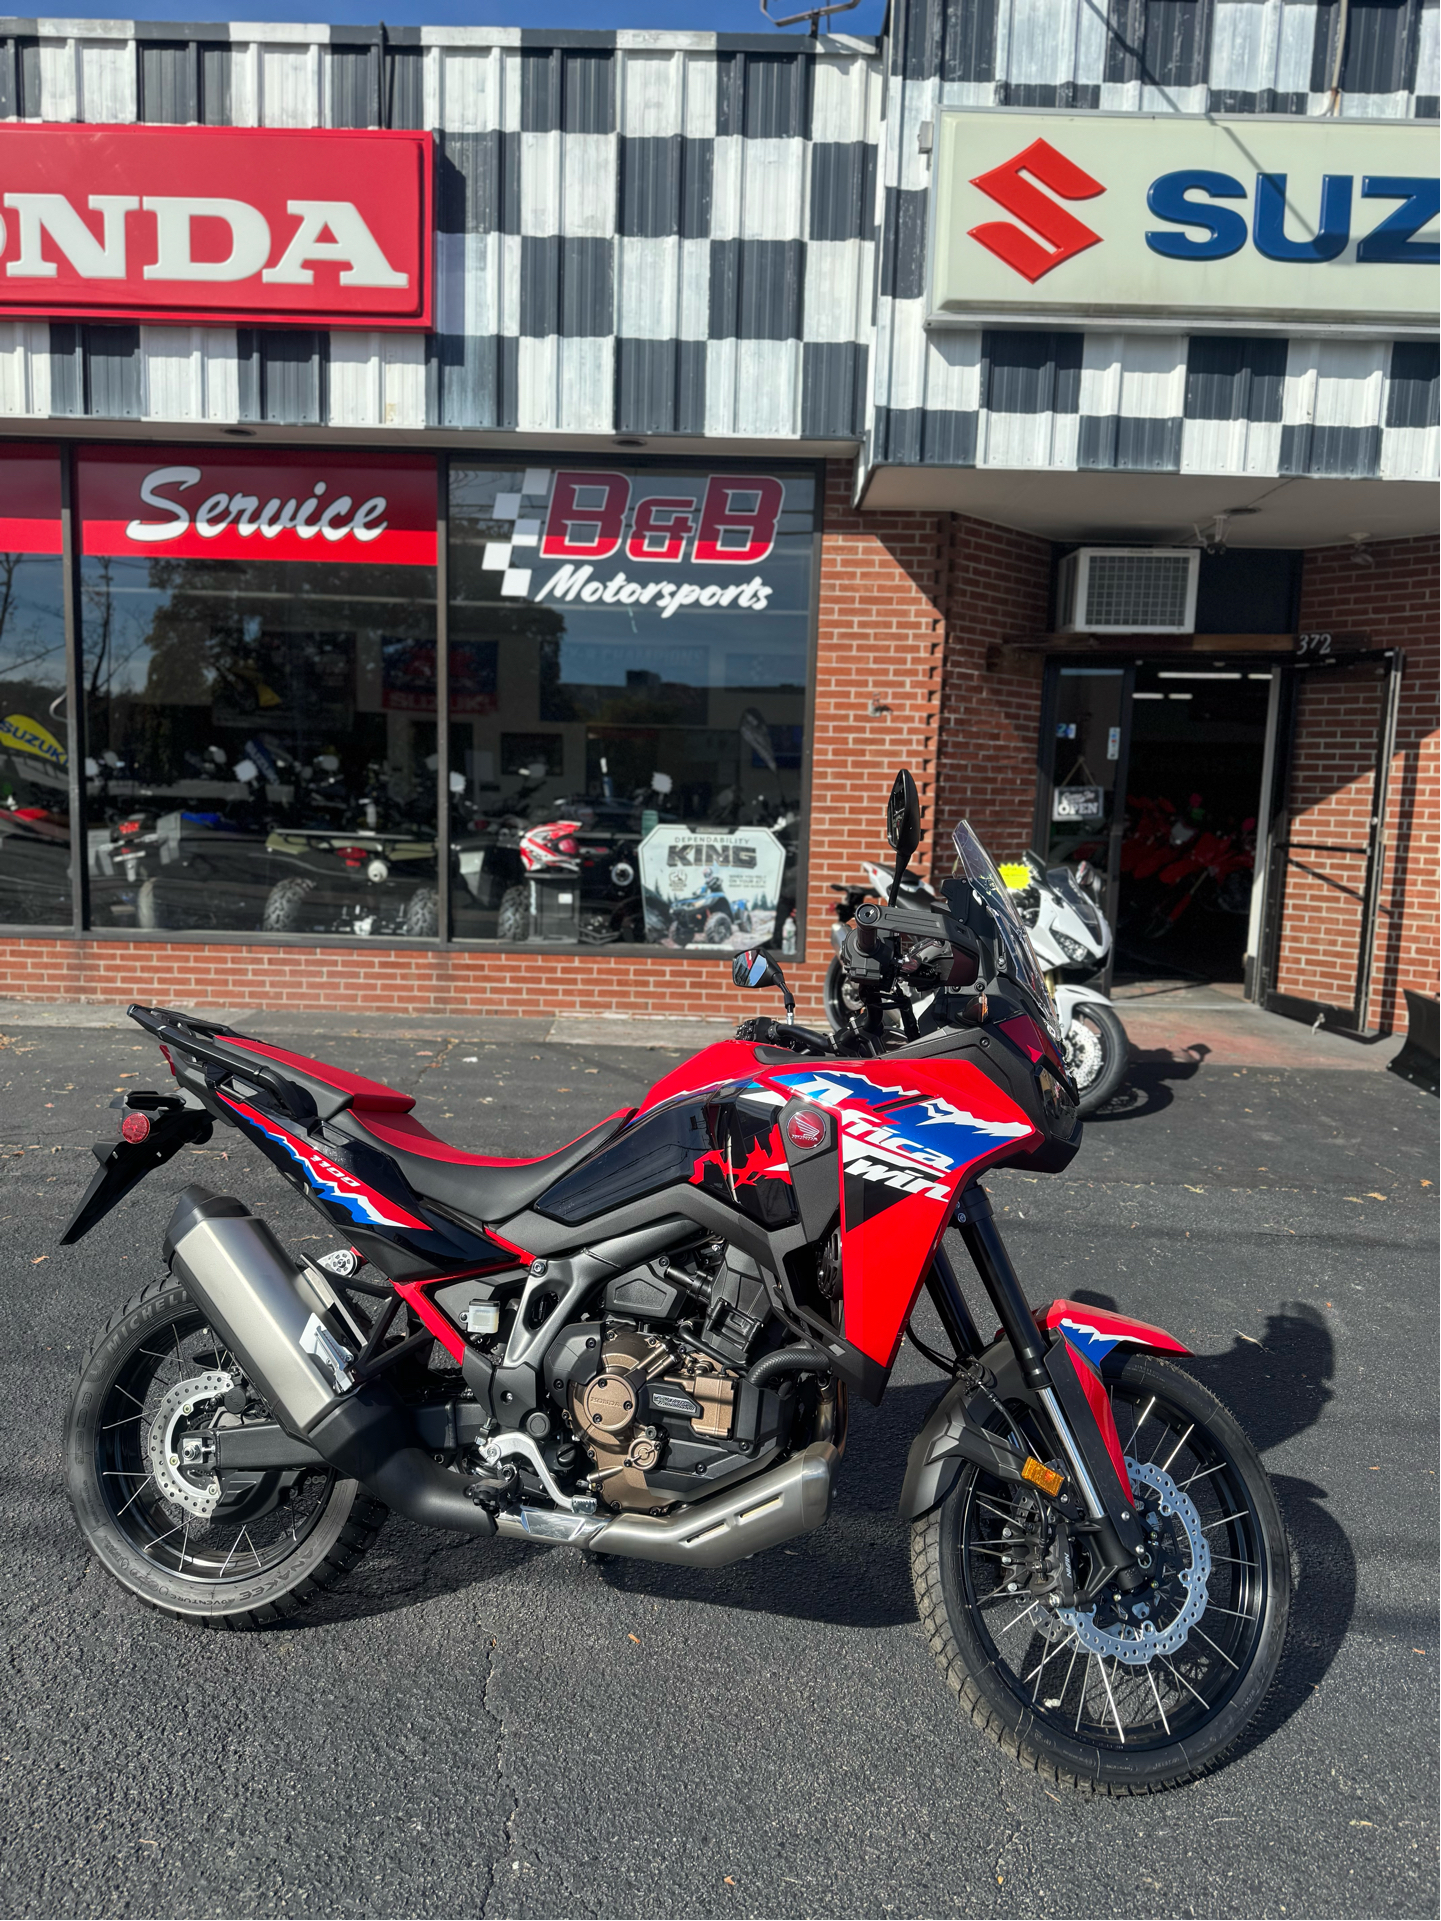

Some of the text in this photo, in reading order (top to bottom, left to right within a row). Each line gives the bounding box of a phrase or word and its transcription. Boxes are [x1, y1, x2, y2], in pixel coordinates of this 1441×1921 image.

[1144, 169, 1441, 264] SUZ
[0, 193, 409, 288] NDA
[125, 465, 389, 543] Service
[539, 470, 785, 565] B&B
[535, 563, 774, 619] Motorsports
[1296, 633, 1332, 655] 372
[1058, 802, 1098, 816] OPEN
[666, 844, 757, 869] KING
[674, 836, 750, 844] DEPENDABILITY
[791, 1134, 818, 1142] HONDA
[310, 1154, 361, 1187] 1100
[590, 1396, 622, 1409] HONDA
[239, 1548, 314, 1601] ANAKEE
